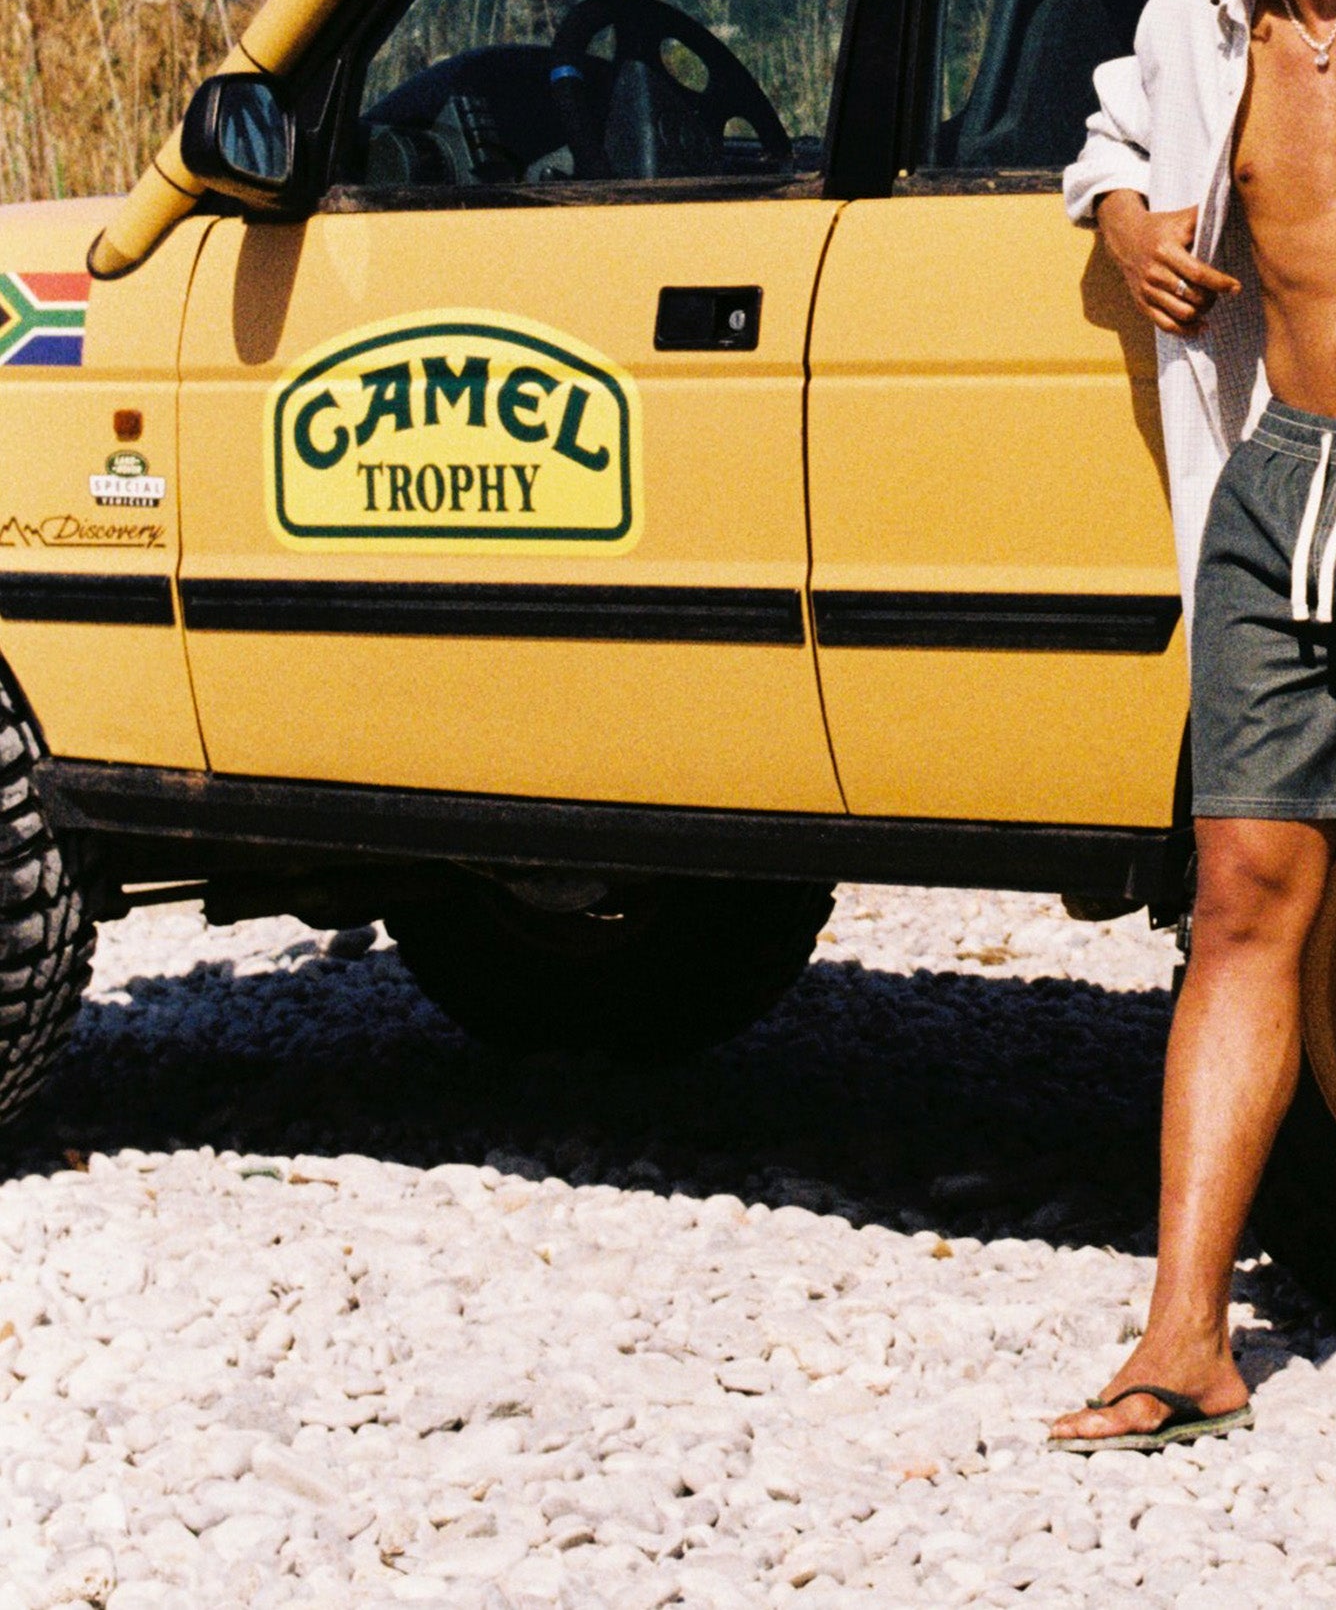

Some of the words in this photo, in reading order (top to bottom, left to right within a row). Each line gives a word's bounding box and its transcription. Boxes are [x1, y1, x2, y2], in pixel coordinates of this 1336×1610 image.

[294, 356, 609, 472] CAMEL
[95, 481, 160, 493] SPECIAL
[357, 462, 541, 513] TROPHY
[41, 515, 165, 548] Discovery
